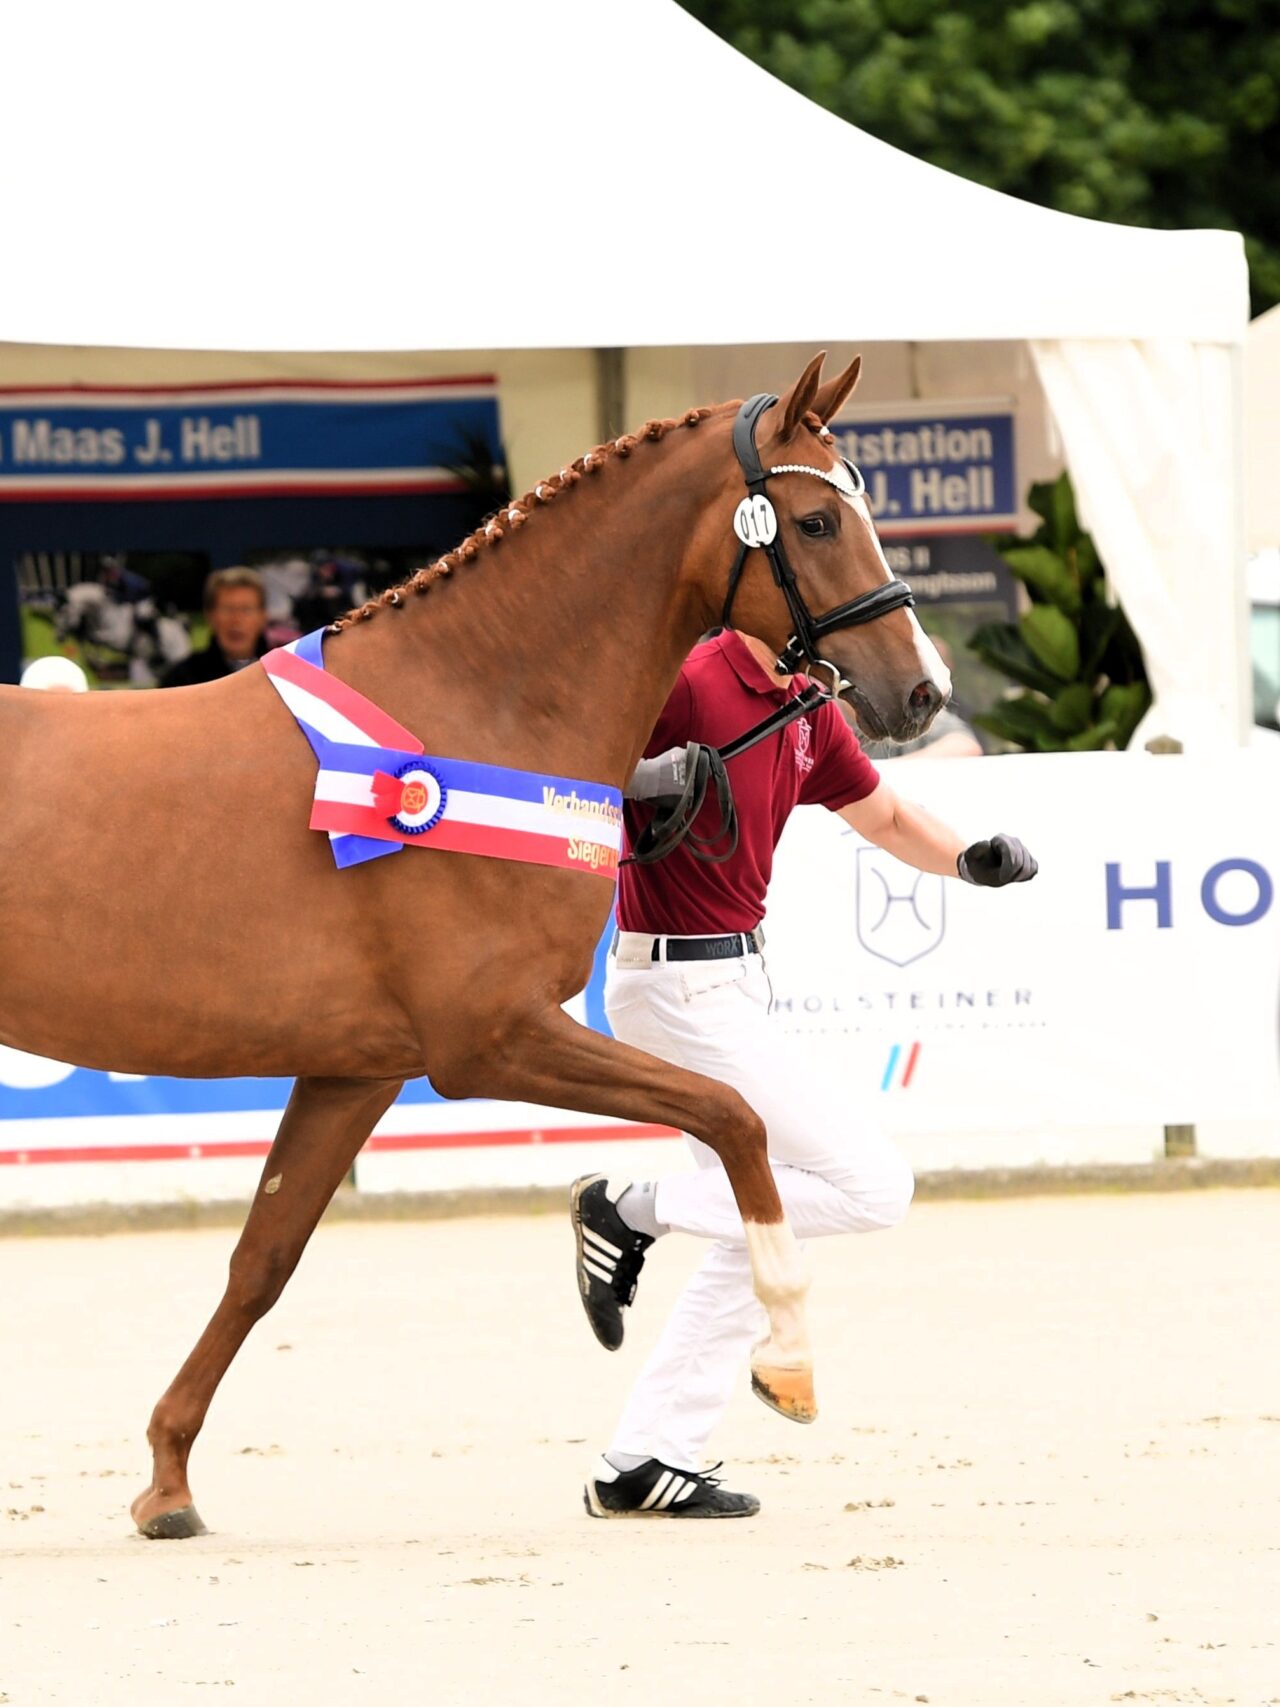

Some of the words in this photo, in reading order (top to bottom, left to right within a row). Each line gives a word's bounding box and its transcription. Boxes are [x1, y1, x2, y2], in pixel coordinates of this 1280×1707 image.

[12, 418, 124, 464] Maas
[134, 419, 172, 463] J.
[181, 415, 260, 461] Hell
[910, 465, 993, 513] Hell
[740, 504, 769, 540] 017
[1105, 858, 1274, 930] HO
[774, 989, 1032, 1013] HOLSTEINER
